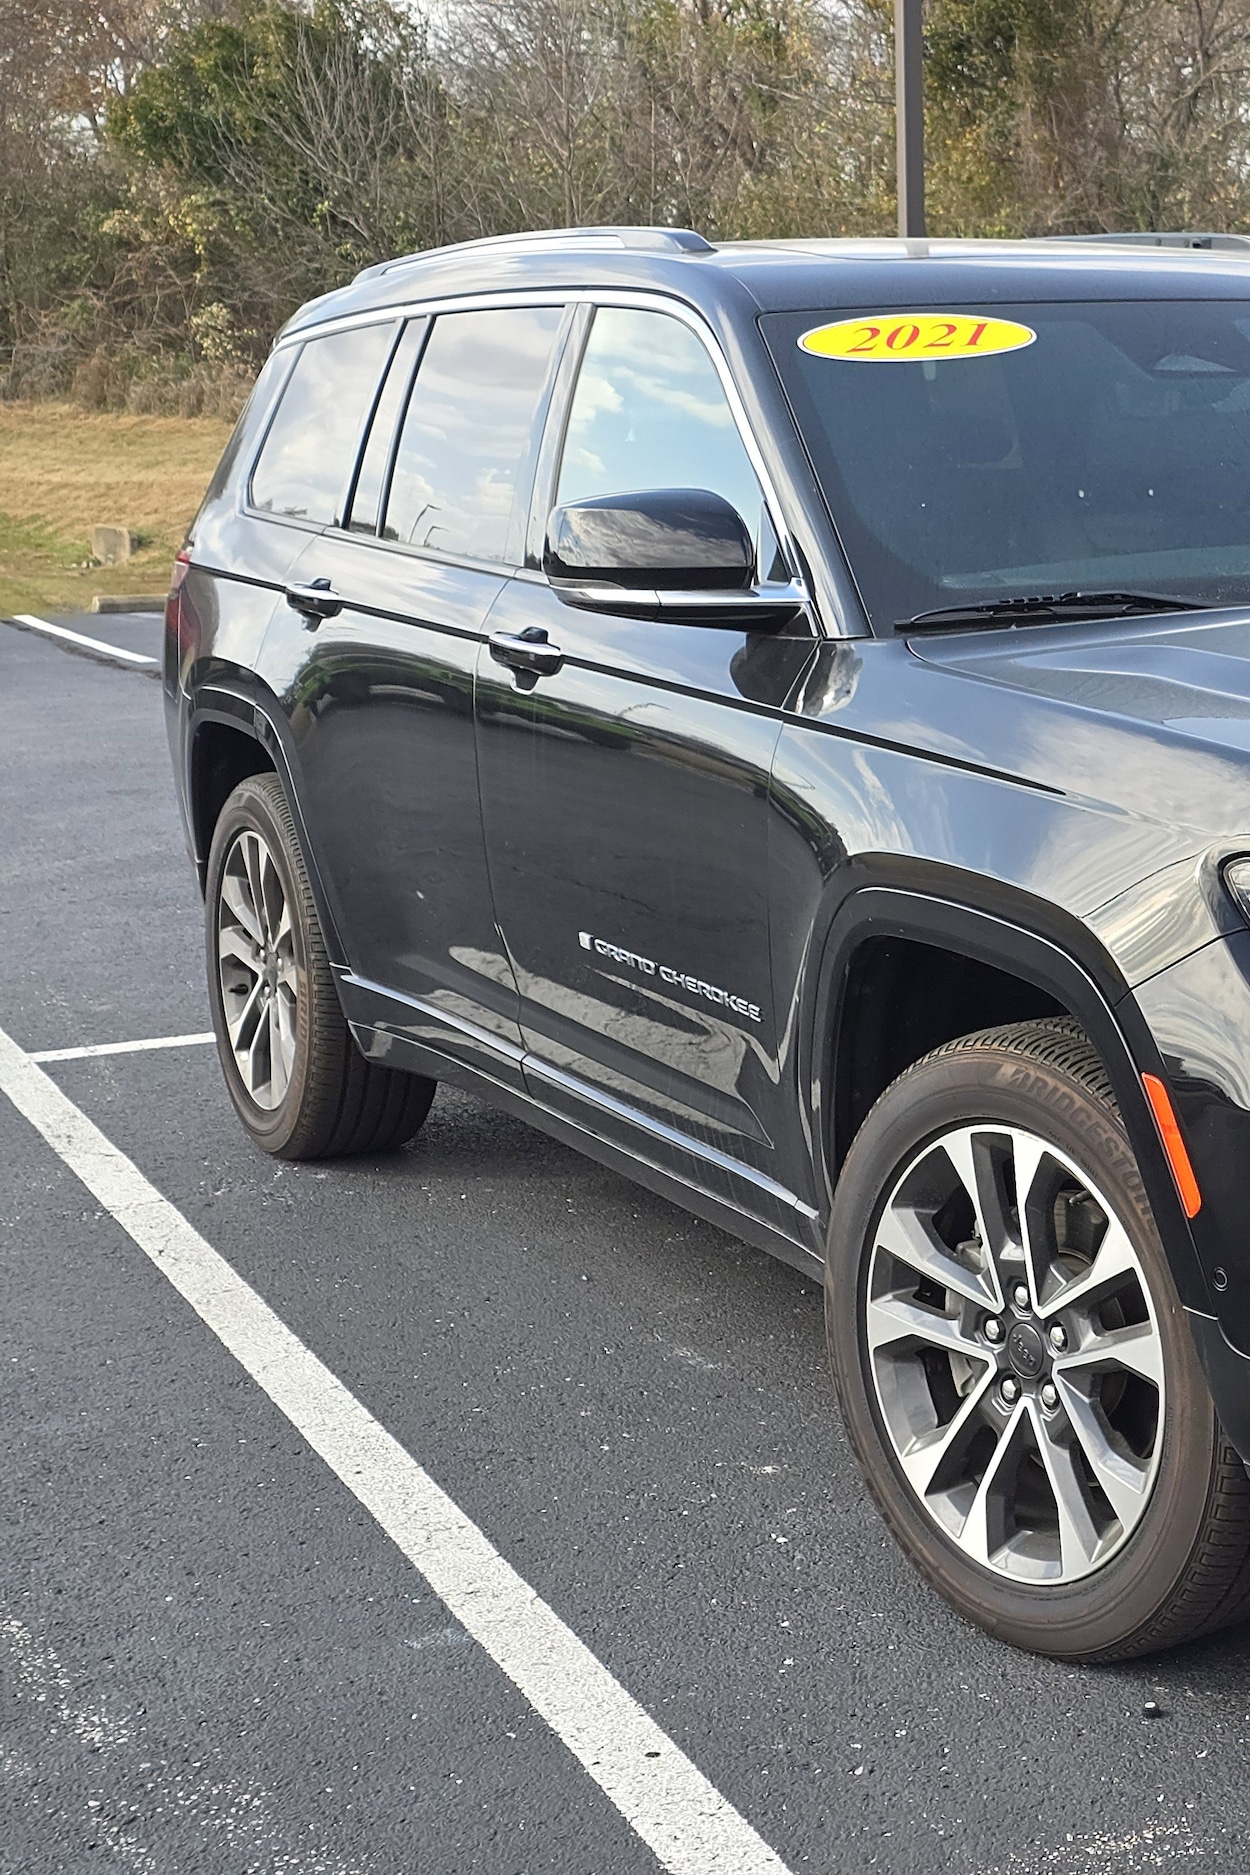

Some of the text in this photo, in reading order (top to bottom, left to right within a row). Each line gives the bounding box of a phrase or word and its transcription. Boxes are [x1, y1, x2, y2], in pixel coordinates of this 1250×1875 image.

[846, 323, 989, 354] 2021
[594, 938, 763, 1023] GRAND CHEROKEE
